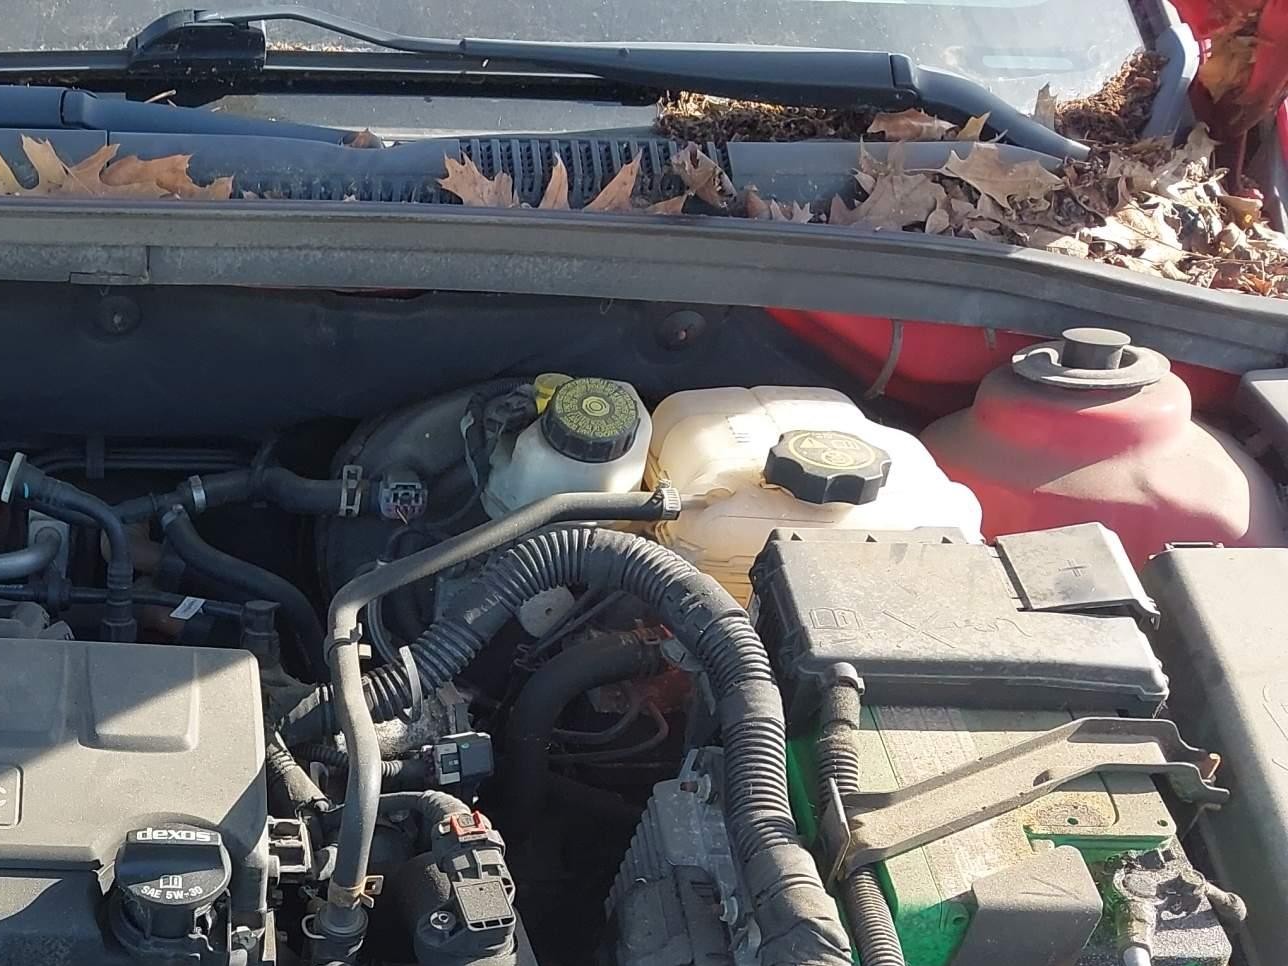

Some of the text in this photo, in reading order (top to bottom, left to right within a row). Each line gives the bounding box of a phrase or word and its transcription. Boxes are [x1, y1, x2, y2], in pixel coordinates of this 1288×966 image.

[136, 827, 211, 841] dexos
[140, 885, 204, 900] SAE 5W-30
